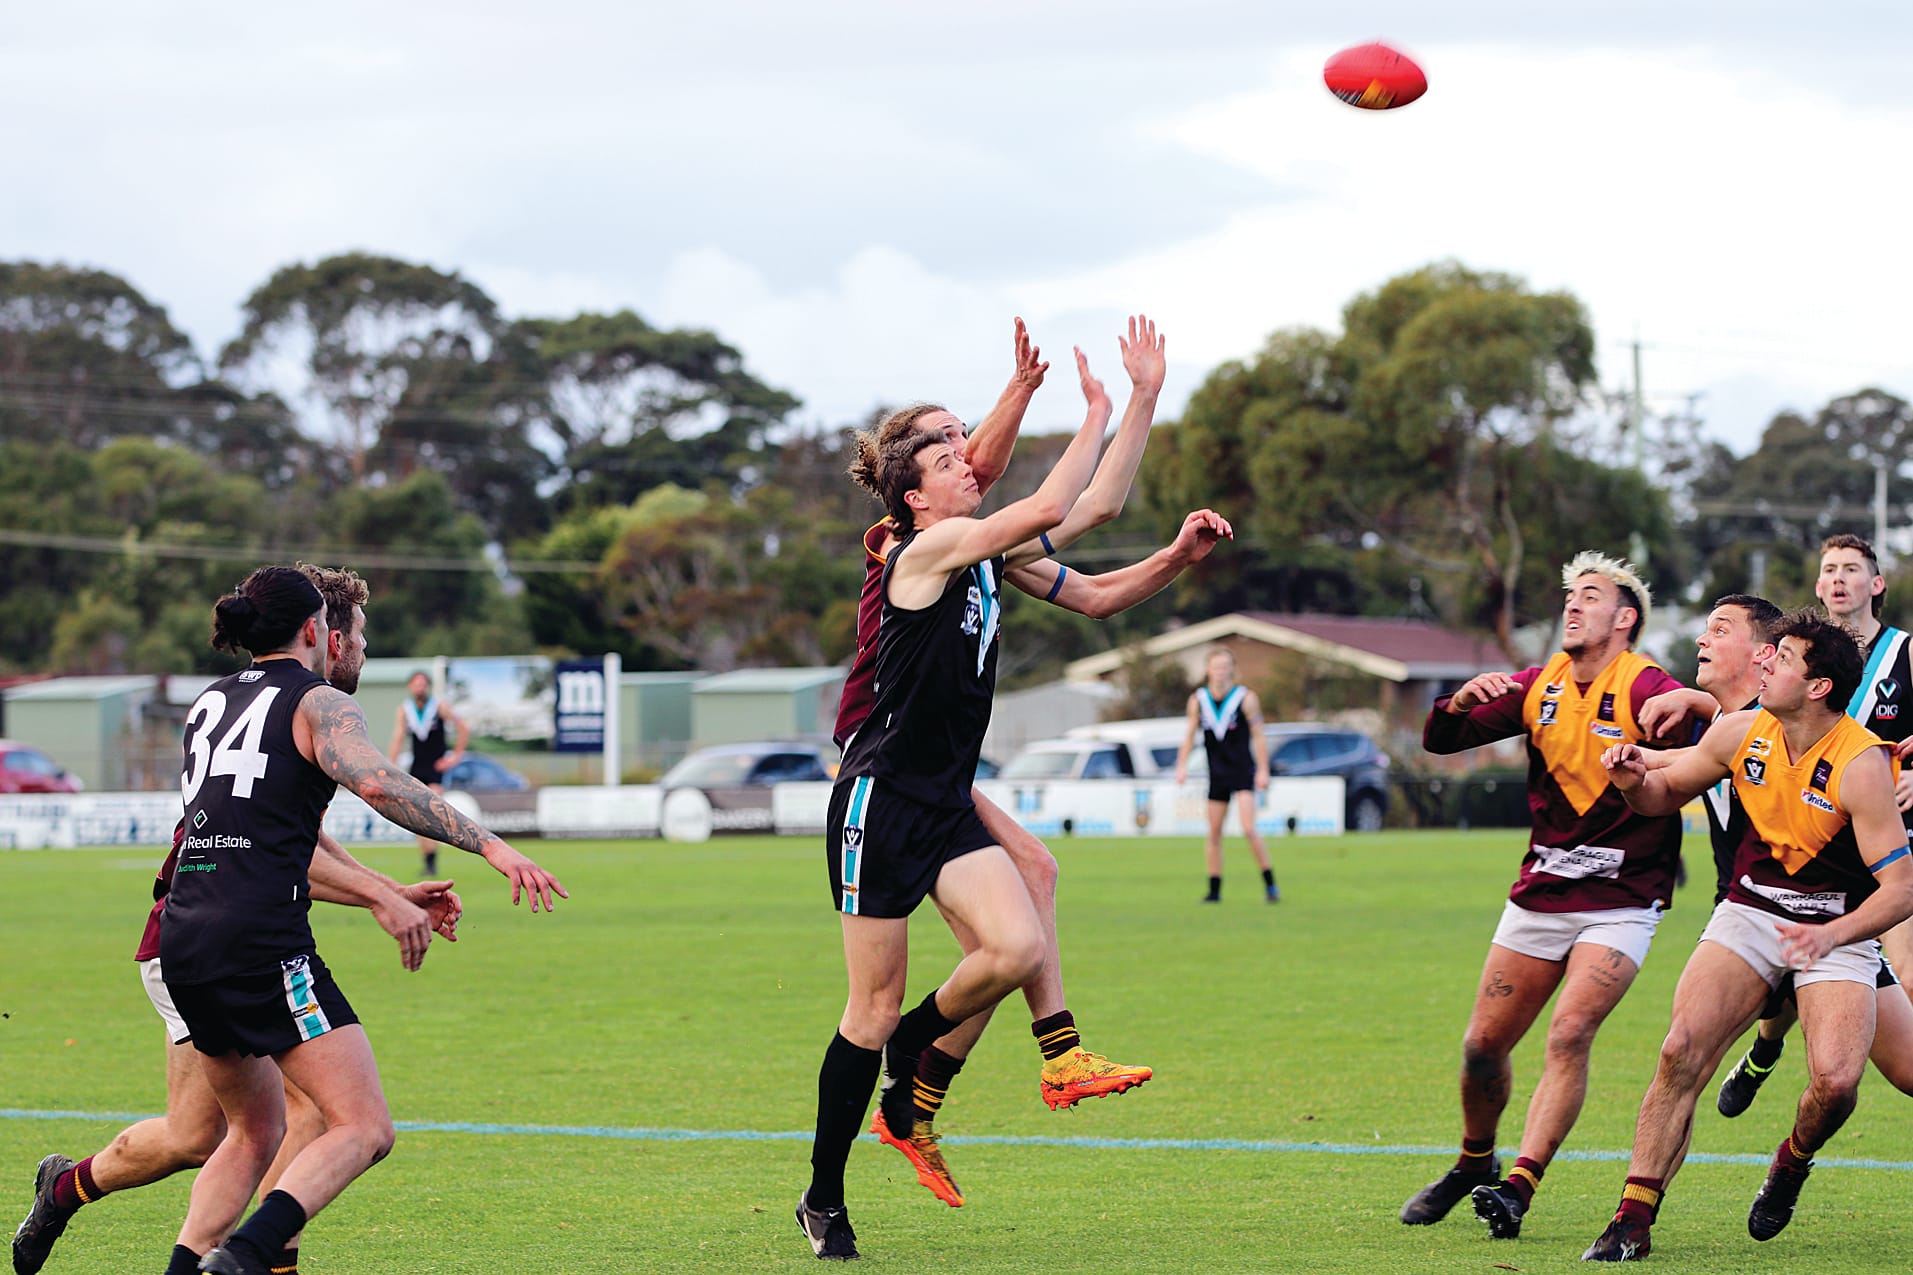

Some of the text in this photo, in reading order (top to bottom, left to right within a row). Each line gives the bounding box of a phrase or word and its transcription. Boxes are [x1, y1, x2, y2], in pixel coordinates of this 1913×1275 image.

[181, 686, 281, 806] 34
[187, 835, 213, 849] Real
[215, 835, 252, 849] Estate
[197, 863, 216, 872] Wright
